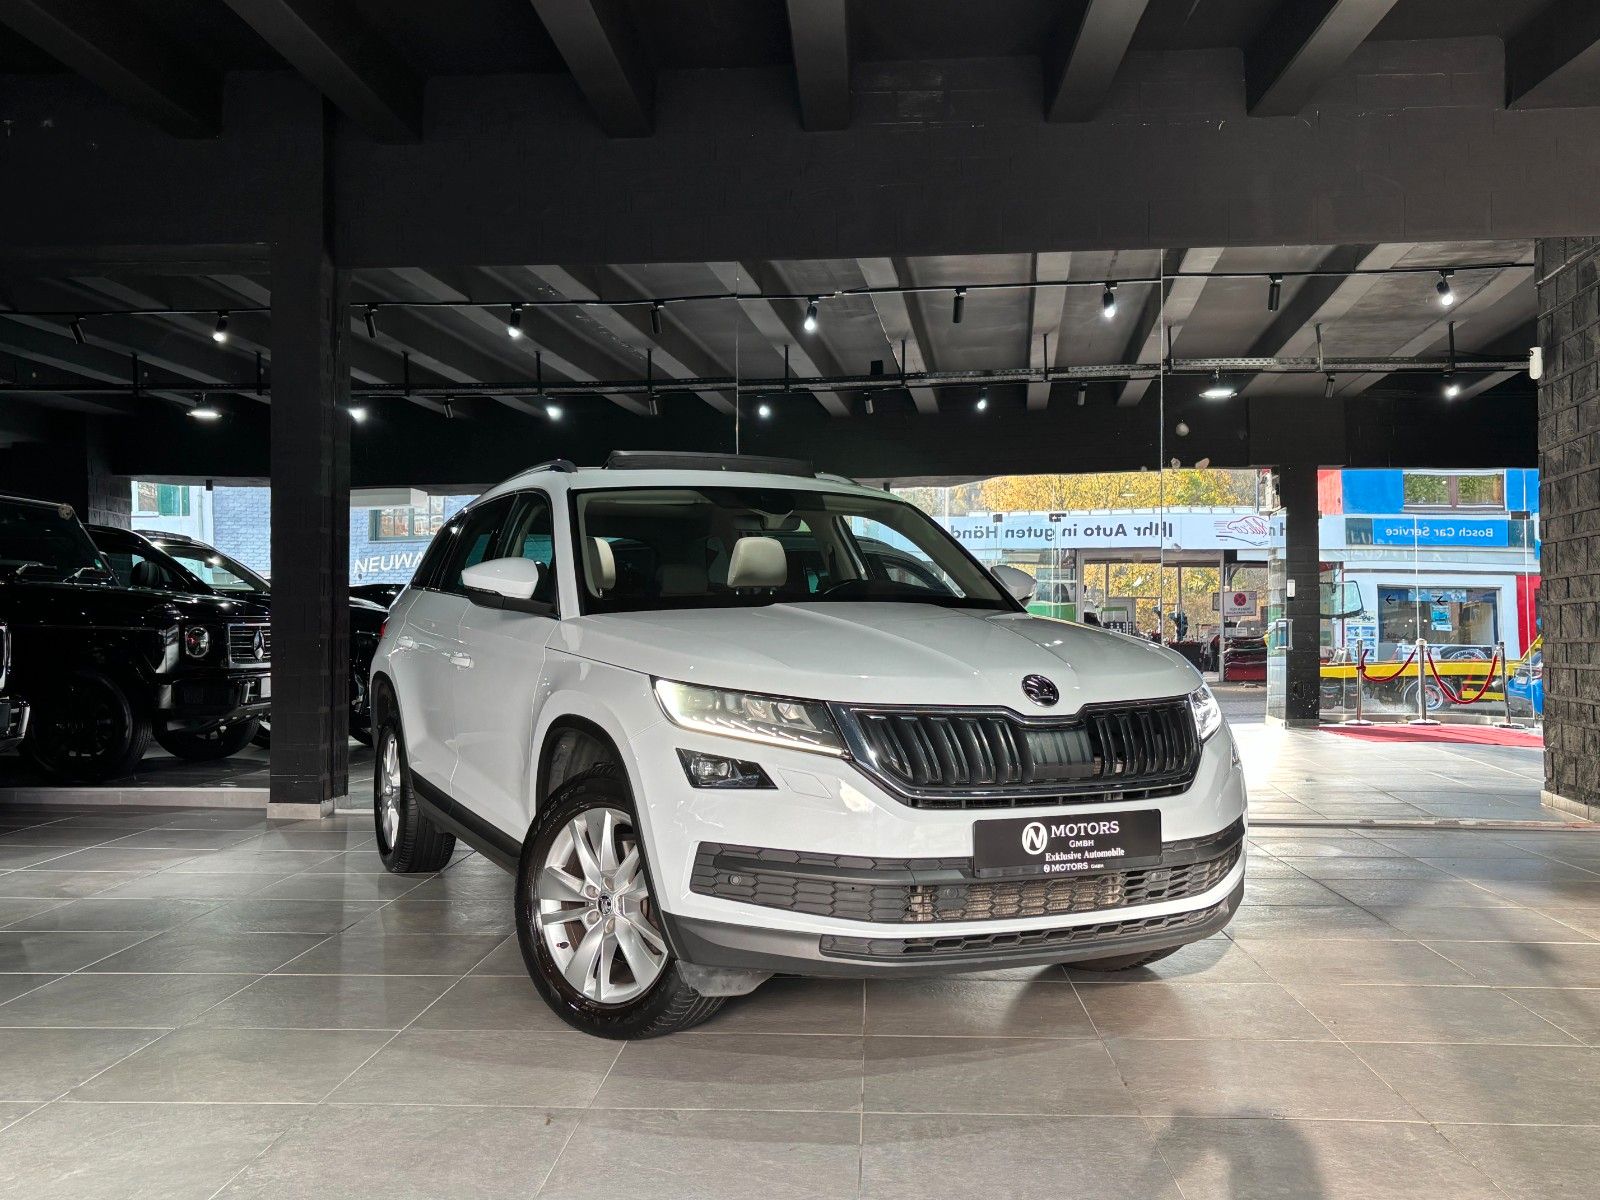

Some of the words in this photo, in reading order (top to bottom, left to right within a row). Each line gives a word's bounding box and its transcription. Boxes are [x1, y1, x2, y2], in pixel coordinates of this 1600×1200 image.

[1050, 820, 1120, 838] MOTORS
[1045, 851, 1082, 862] Exklusive
[1083, 848, 1125, 860] Automobile
[1051, 862, 1089, 872] MOTORS
